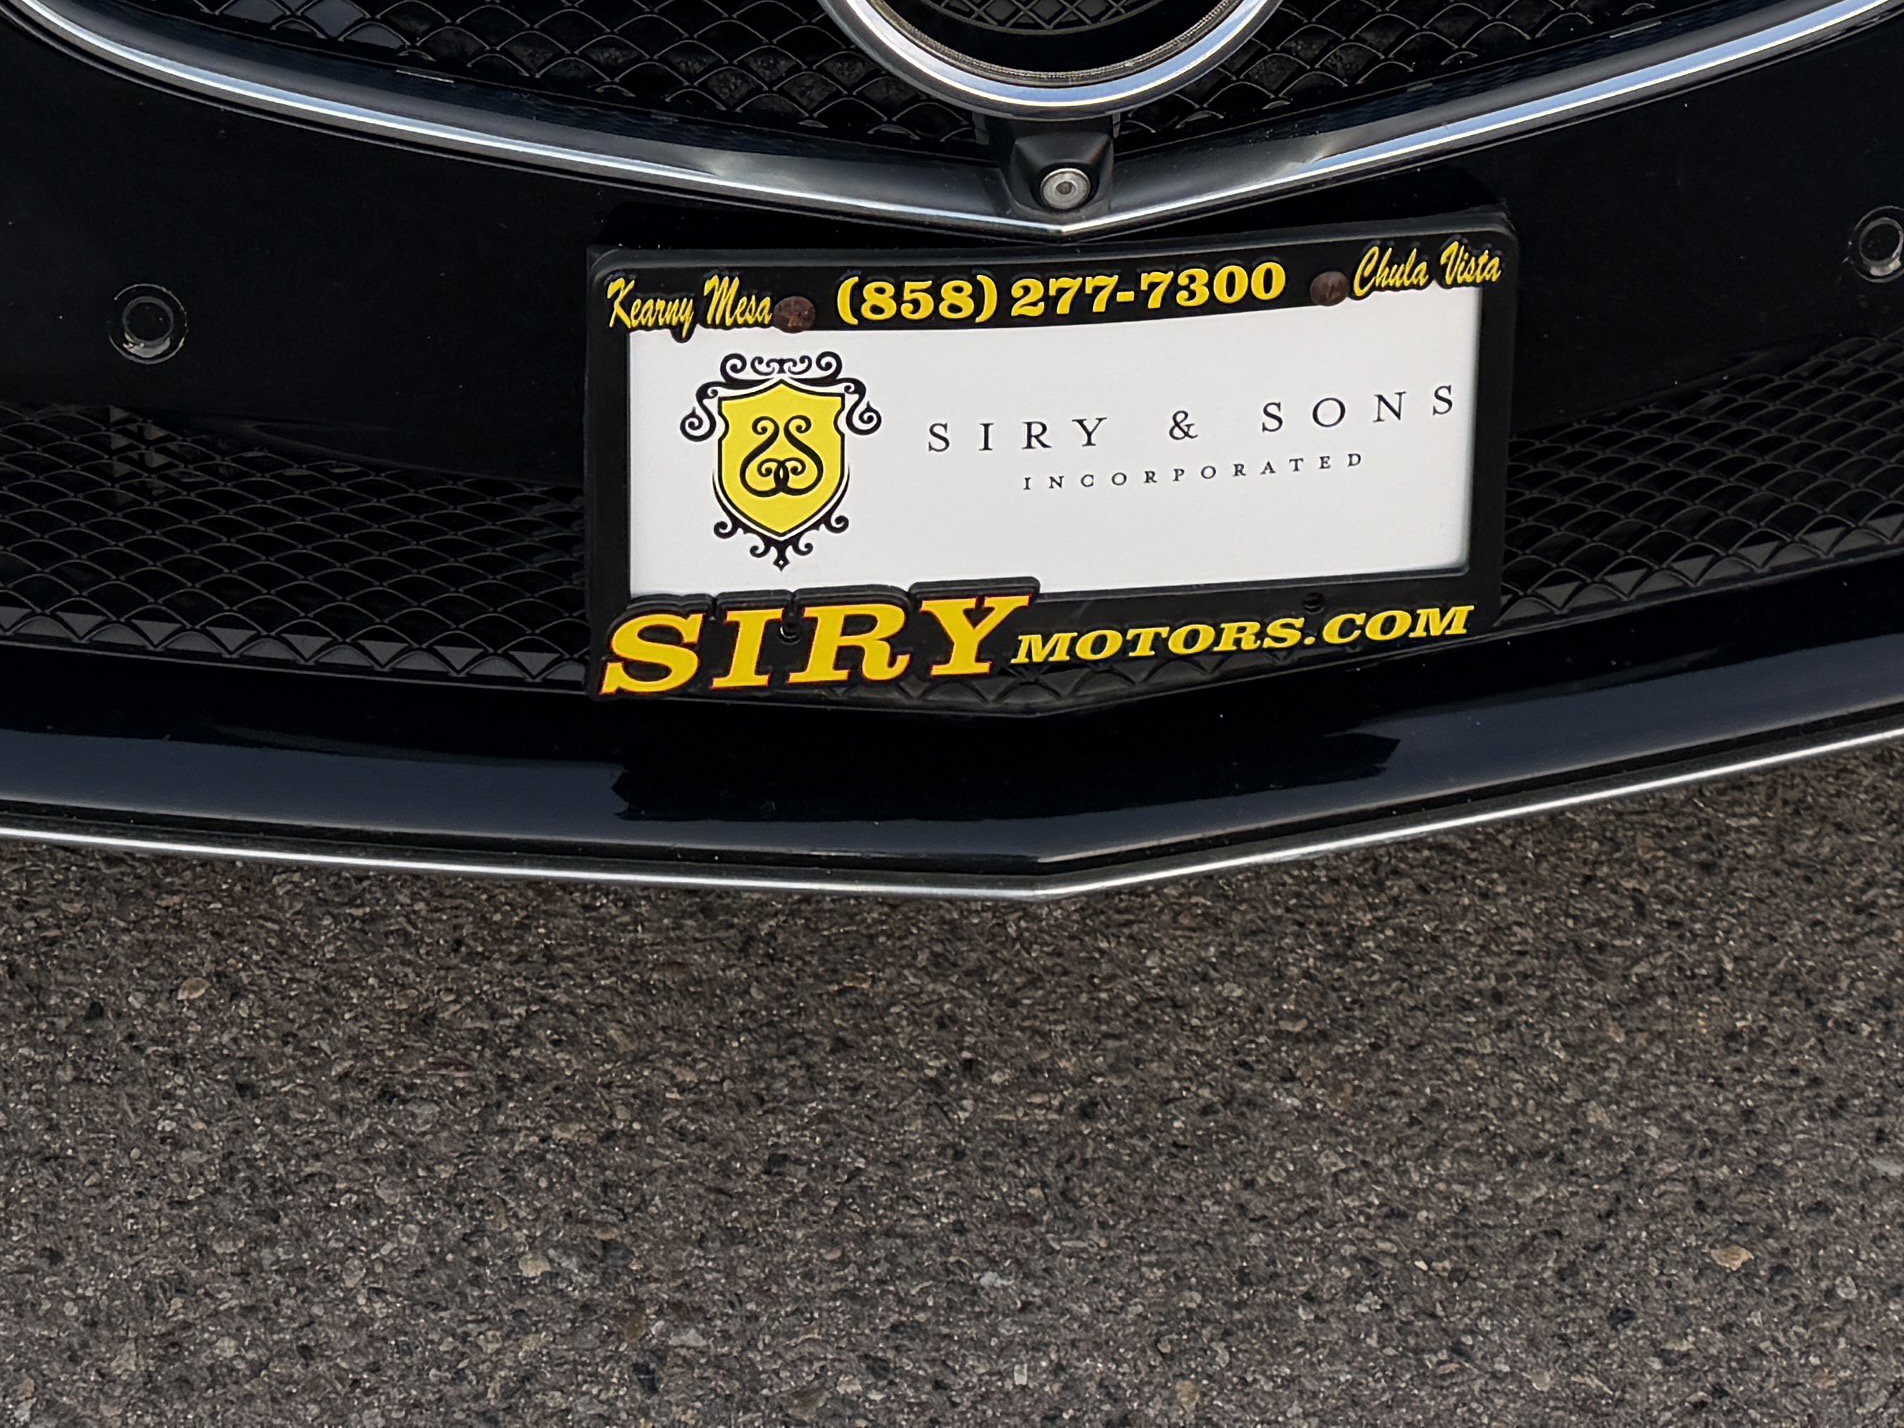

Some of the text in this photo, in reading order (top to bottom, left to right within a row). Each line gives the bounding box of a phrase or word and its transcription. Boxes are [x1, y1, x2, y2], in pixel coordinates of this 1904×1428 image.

[606, 240, 1503, 340] Kearny Mesa (858) 277-7300 Chula Vista
[926, 383, 1454, 452] SIRY & SONS
[1022, 451, 1364, 491] INCORPORATED
[599, 592, 1476, 696] SIRY MOTORS.COM
